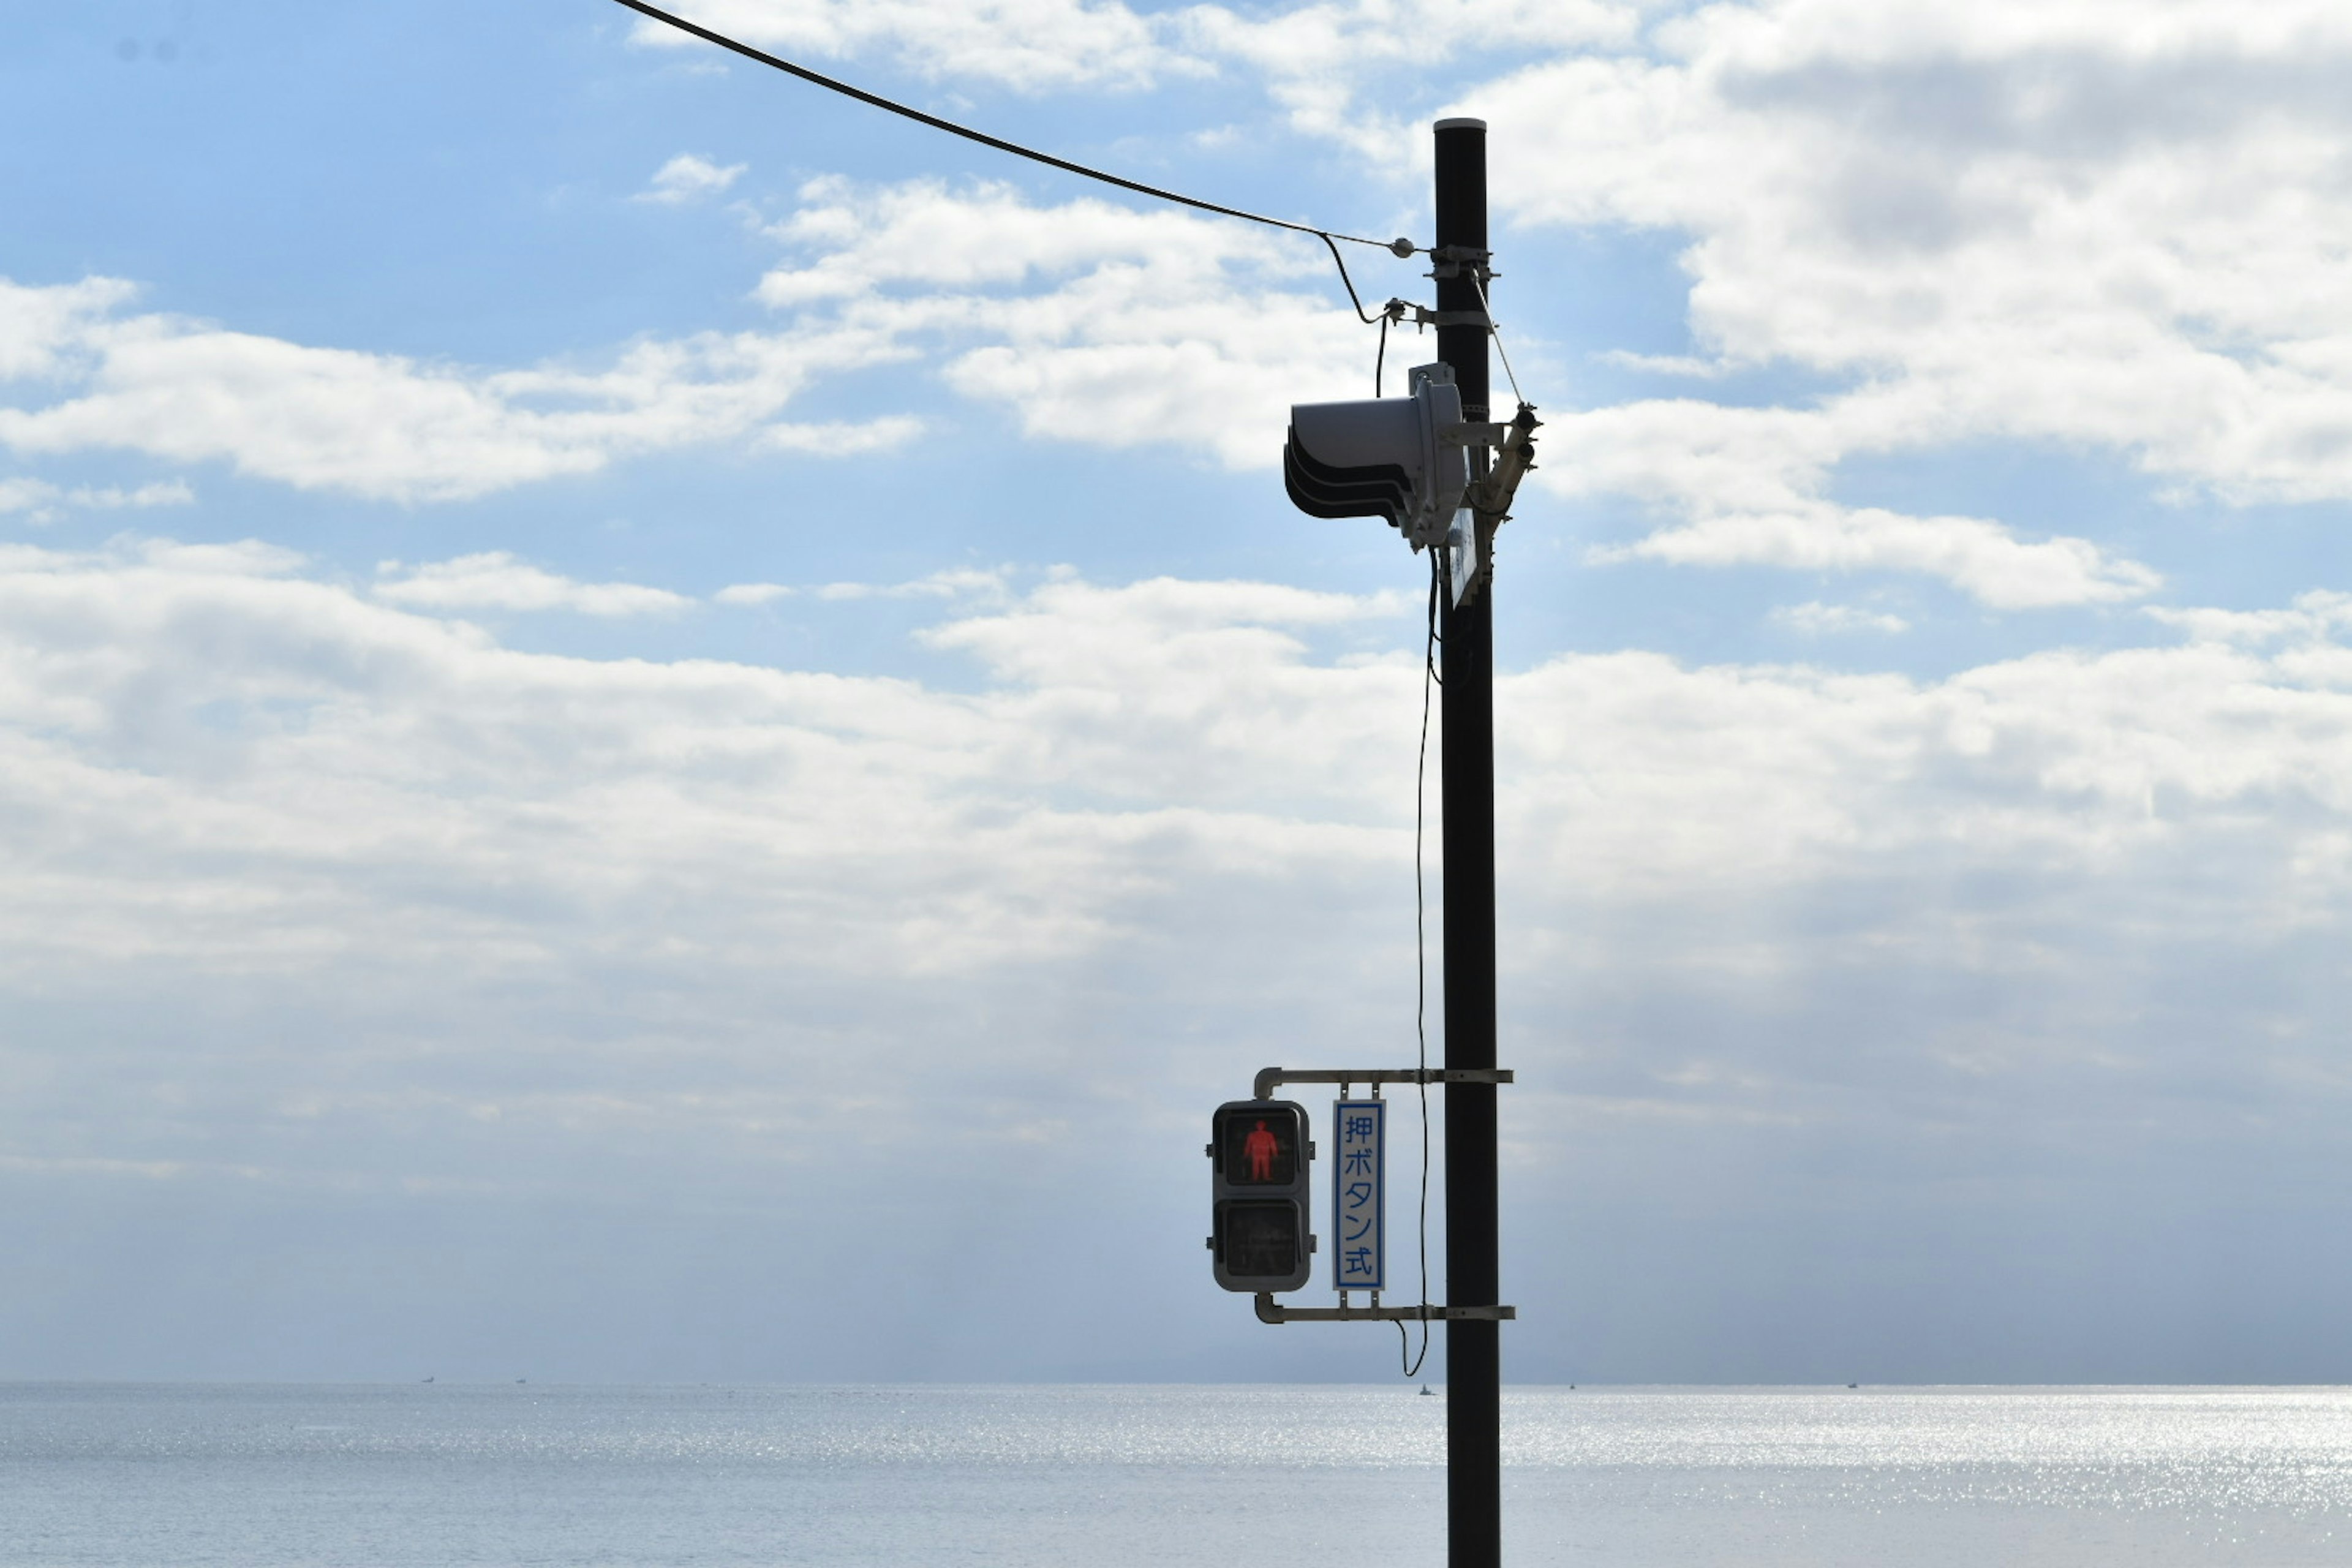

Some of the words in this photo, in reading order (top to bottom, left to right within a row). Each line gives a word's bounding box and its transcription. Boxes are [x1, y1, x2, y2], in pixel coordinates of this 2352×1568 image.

[1345, 1116, 1373, 1275] 押ボタン式
